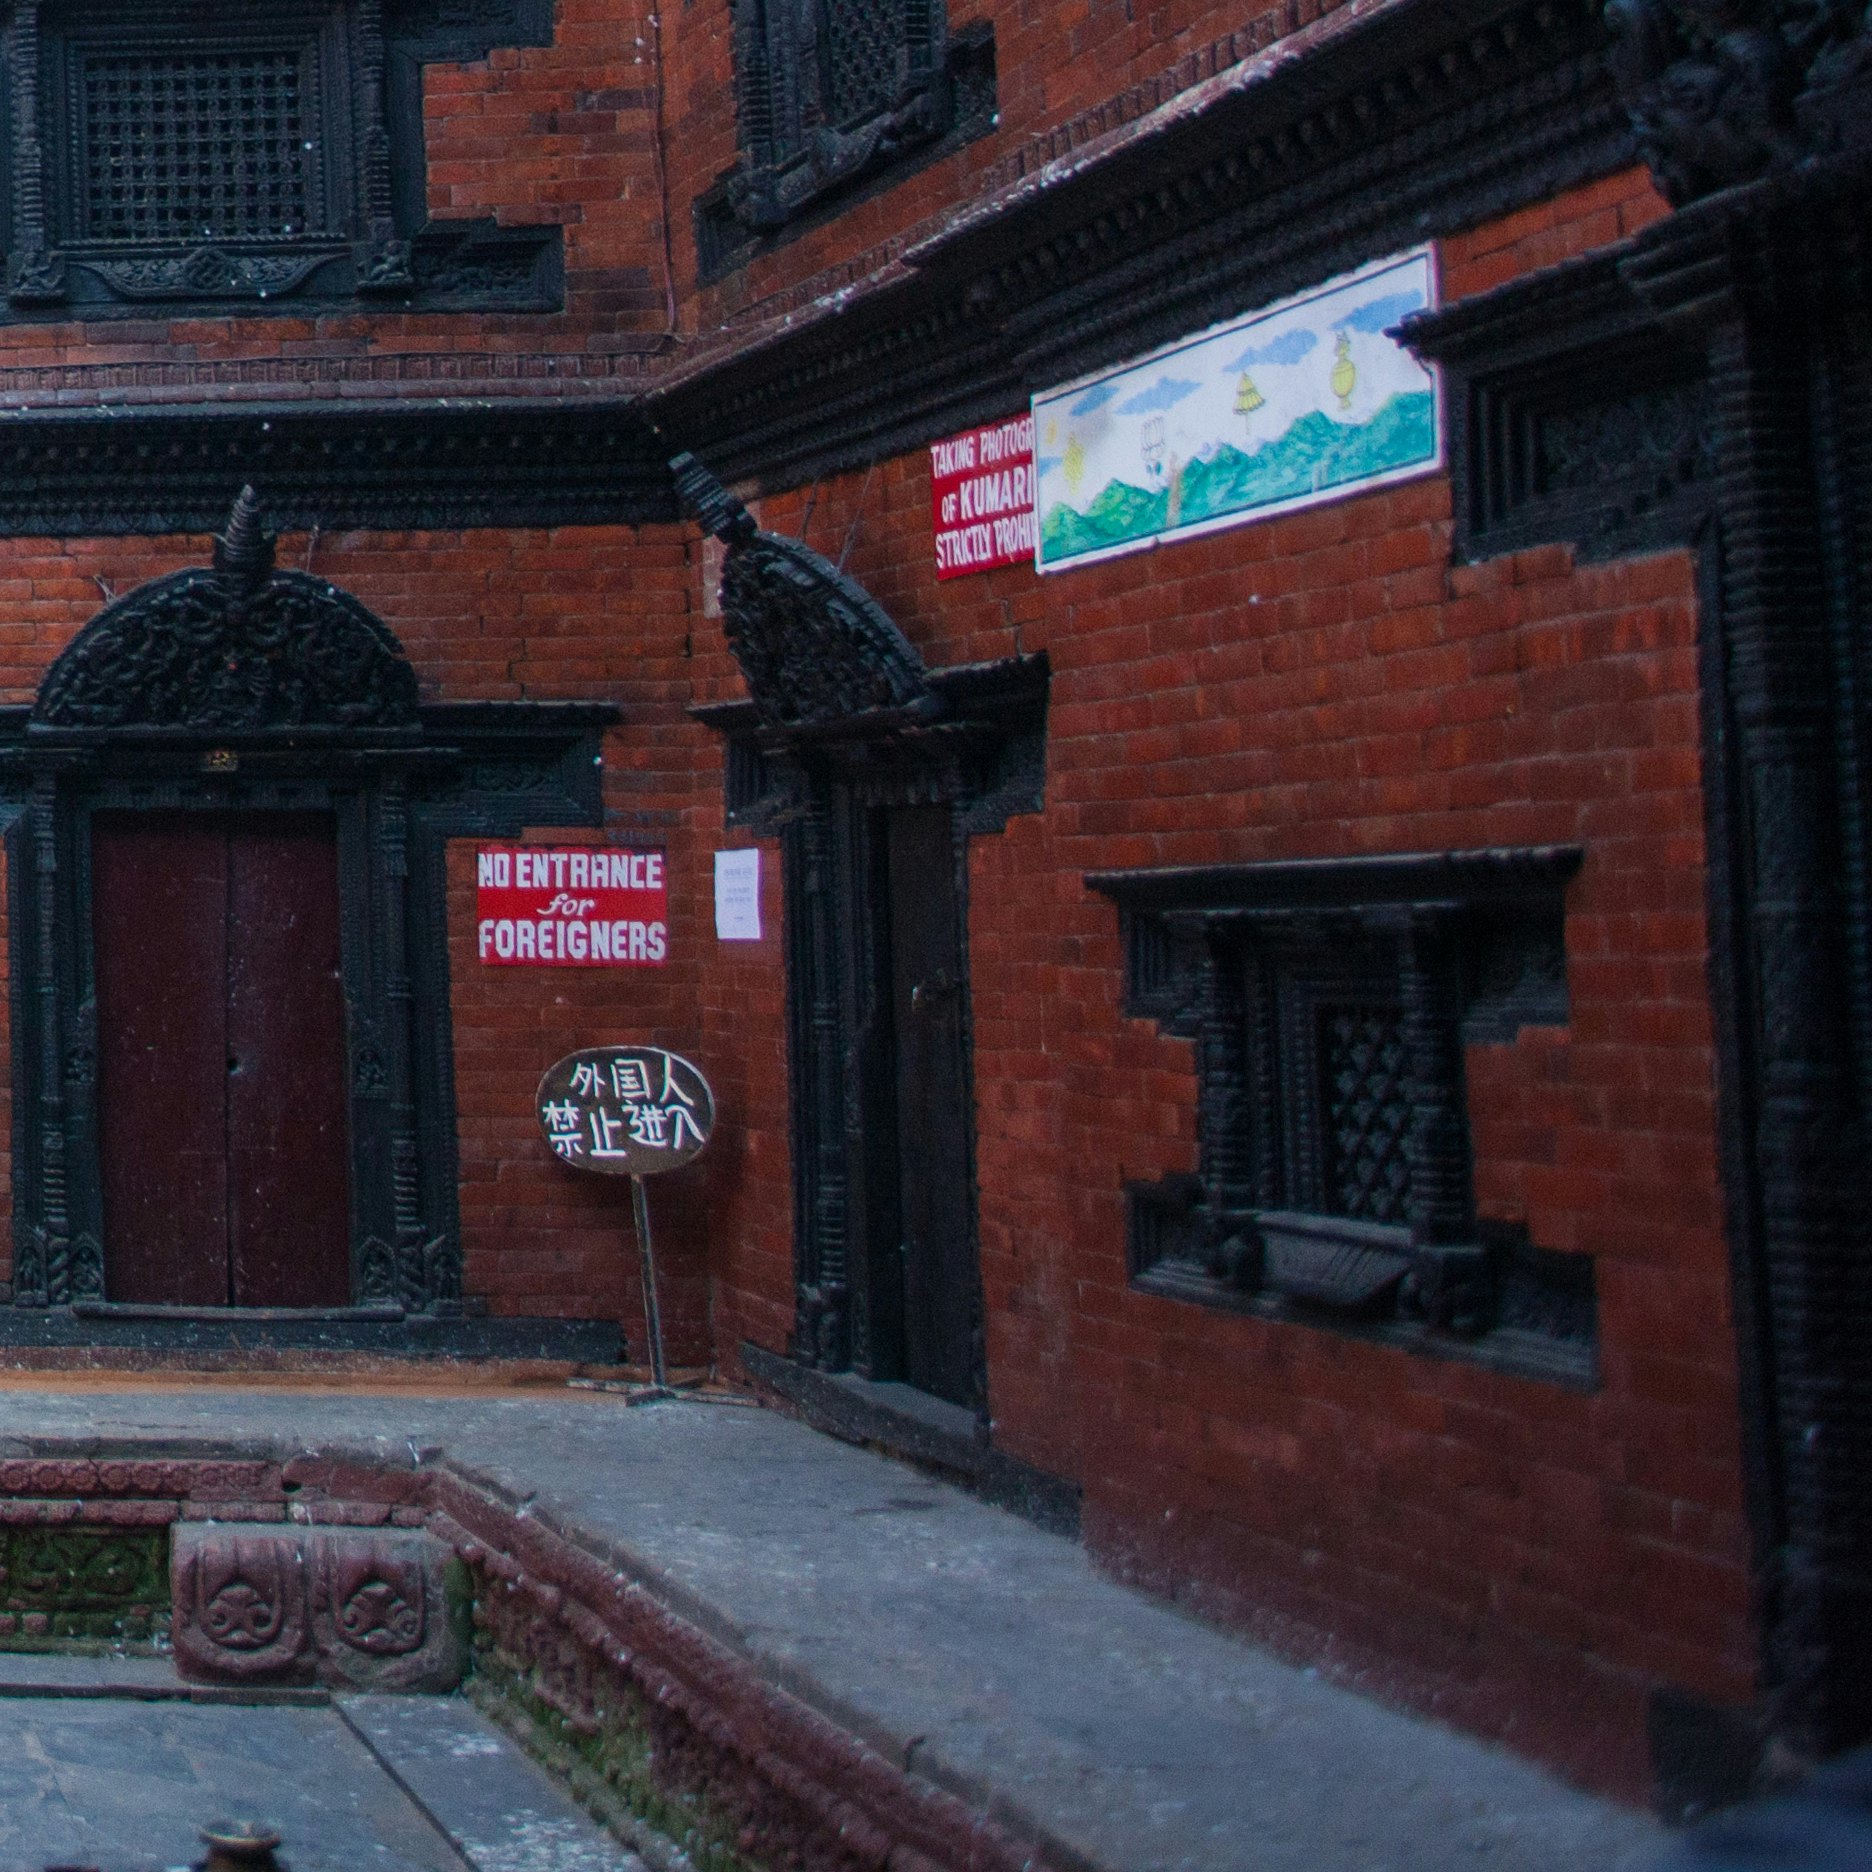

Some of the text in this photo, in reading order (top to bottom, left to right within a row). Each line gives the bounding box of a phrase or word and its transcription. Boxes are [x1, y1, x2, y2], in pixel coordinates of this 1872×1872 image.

[930, 436, 974, 479] TAKING
[942, 464, 1033, 523] OF KUMARI
[936, 523, 991, 569] STRICTLY
[478, 853, 663, 889] NO ENTRANCE
[536, 893, 595, 916] for
[478, 919, 666, 961] FOREIGNERS
[569, 1055, 695, 1106] 外国人
[542, 1098, 706, 1158] 禁止进入
